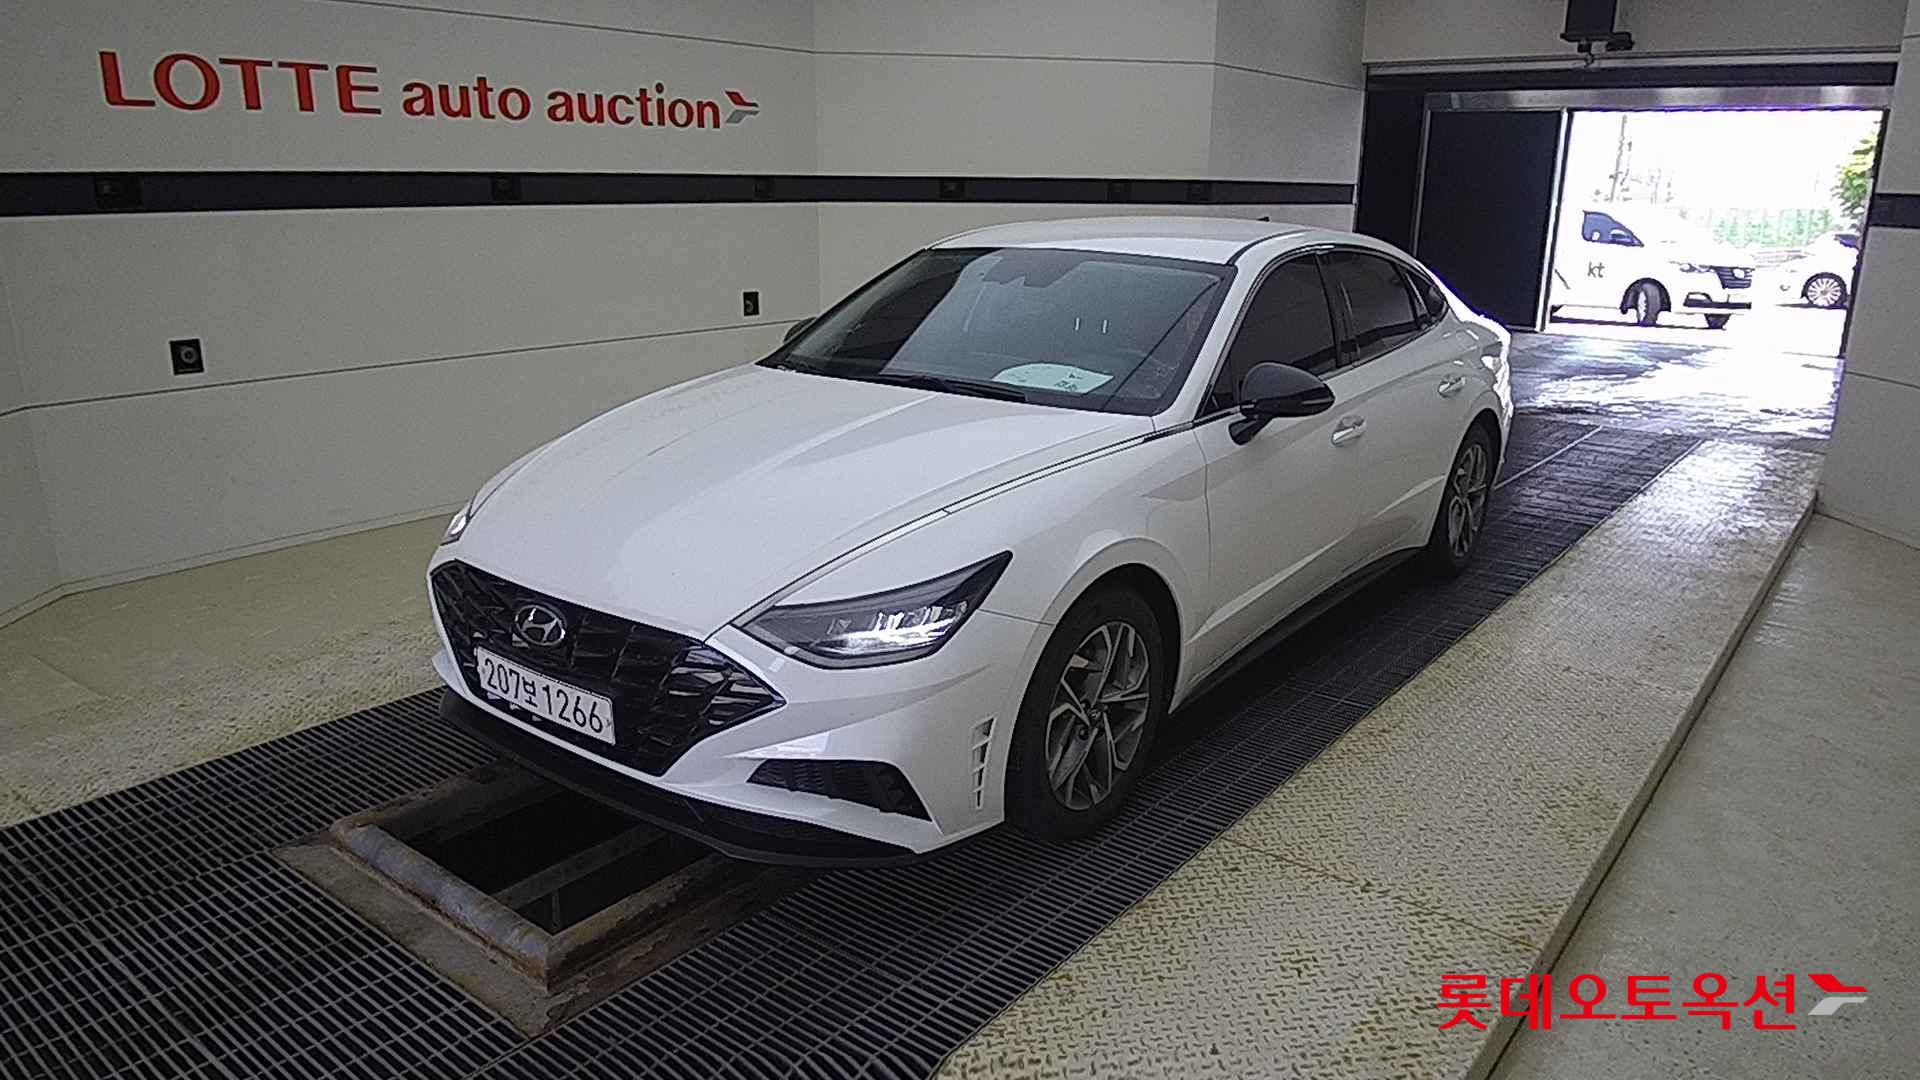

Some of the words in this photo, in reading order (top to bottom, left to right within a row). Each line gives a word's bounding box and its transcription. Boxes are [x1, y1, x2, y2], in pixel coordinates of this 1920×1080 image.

[98, 50, 382, 115] LOTTE
[404, 77, 530, 119] auto
[548, 83, 721, 129] auction
[1587, 261, 1606, 278] kt
[485, 659, 603, 733] 207보1266
